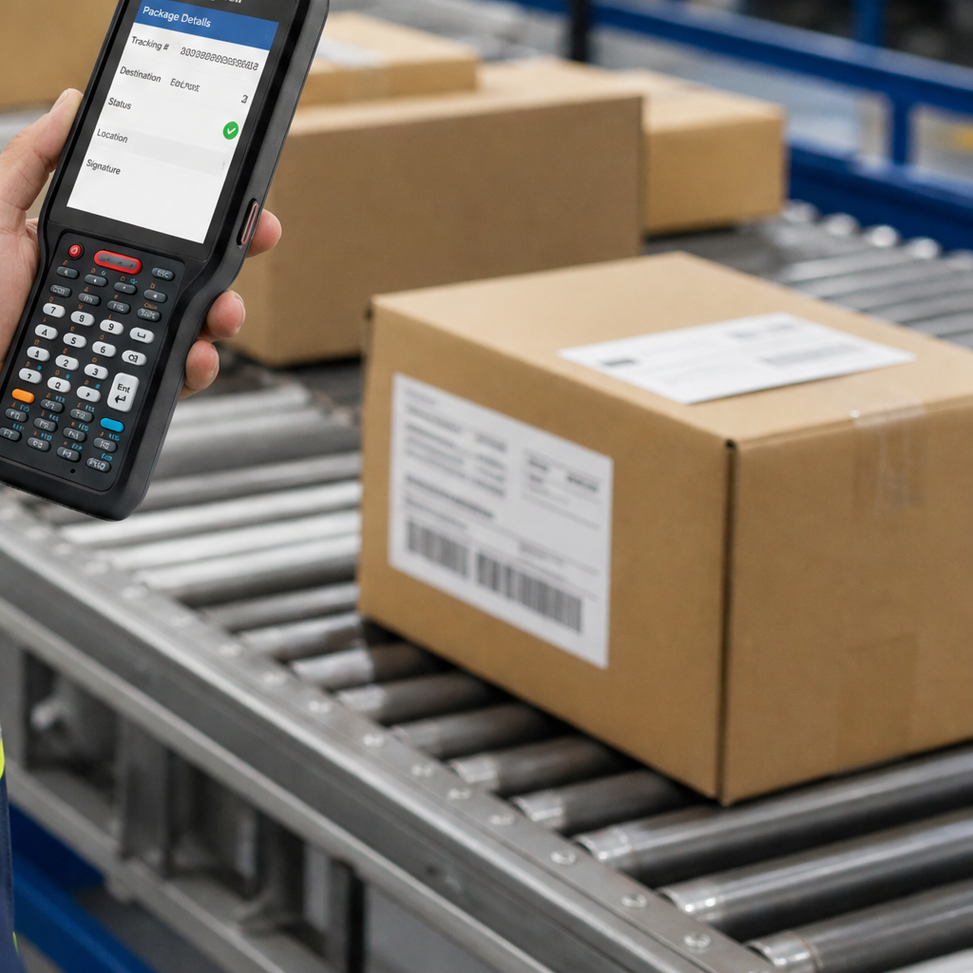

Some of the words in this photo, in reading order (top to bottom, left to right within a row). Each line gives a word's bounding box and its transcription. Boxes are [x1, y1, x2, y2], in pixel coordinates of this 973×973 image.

[142, 6, 179, 22] Package
[181, 13, 211, 28] Details
[131, 36, 163, 51] Tracking
[120, 66, 162, 83] Destination
[108, 97, 132, 110] Status
[97, 129, 128, 144] Location
[86, 159, 121, 176] Signature
[108, 323, 114, 331] 9
[100, 346, 106, 354] 6
[117, 383, 130, 394] Ent
